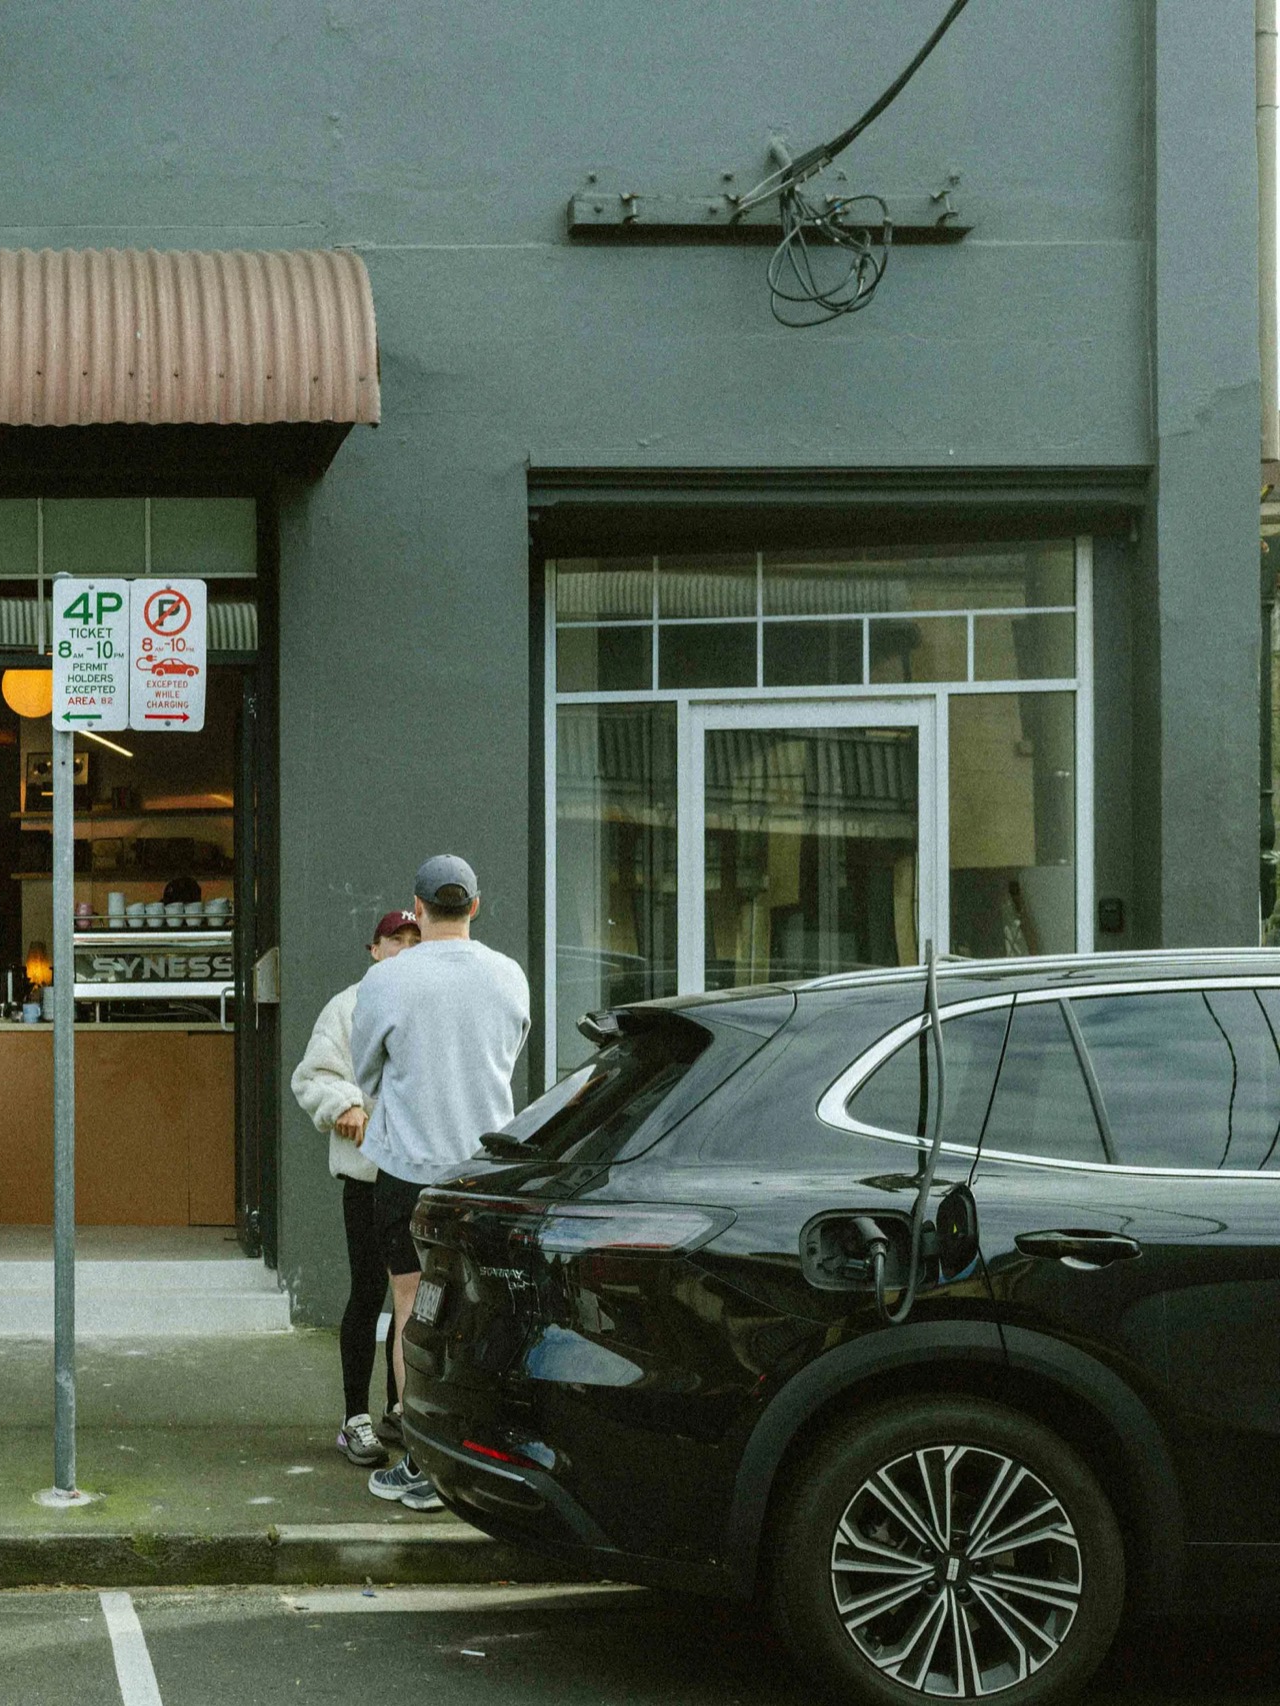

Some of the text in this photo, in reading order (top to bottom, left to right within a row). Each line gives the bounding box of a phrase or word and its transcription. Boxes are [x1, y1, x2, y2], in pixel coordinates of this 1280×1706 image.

[63, 592, 123, 625] 4P
[69, 628, 113, 639] TICKET
[73, 663, 108, 672] PERMIT
[67, 674, 114, 683] HOLDERS
[147, 680, 189, 688] EXCEPTED
[65, 685, 116, 694] EXCEPTED
[155, 691, 180, 699] WHILE
[68, 696, 96, 706] AREA
[147, 701, 189, 709] CHARGING
